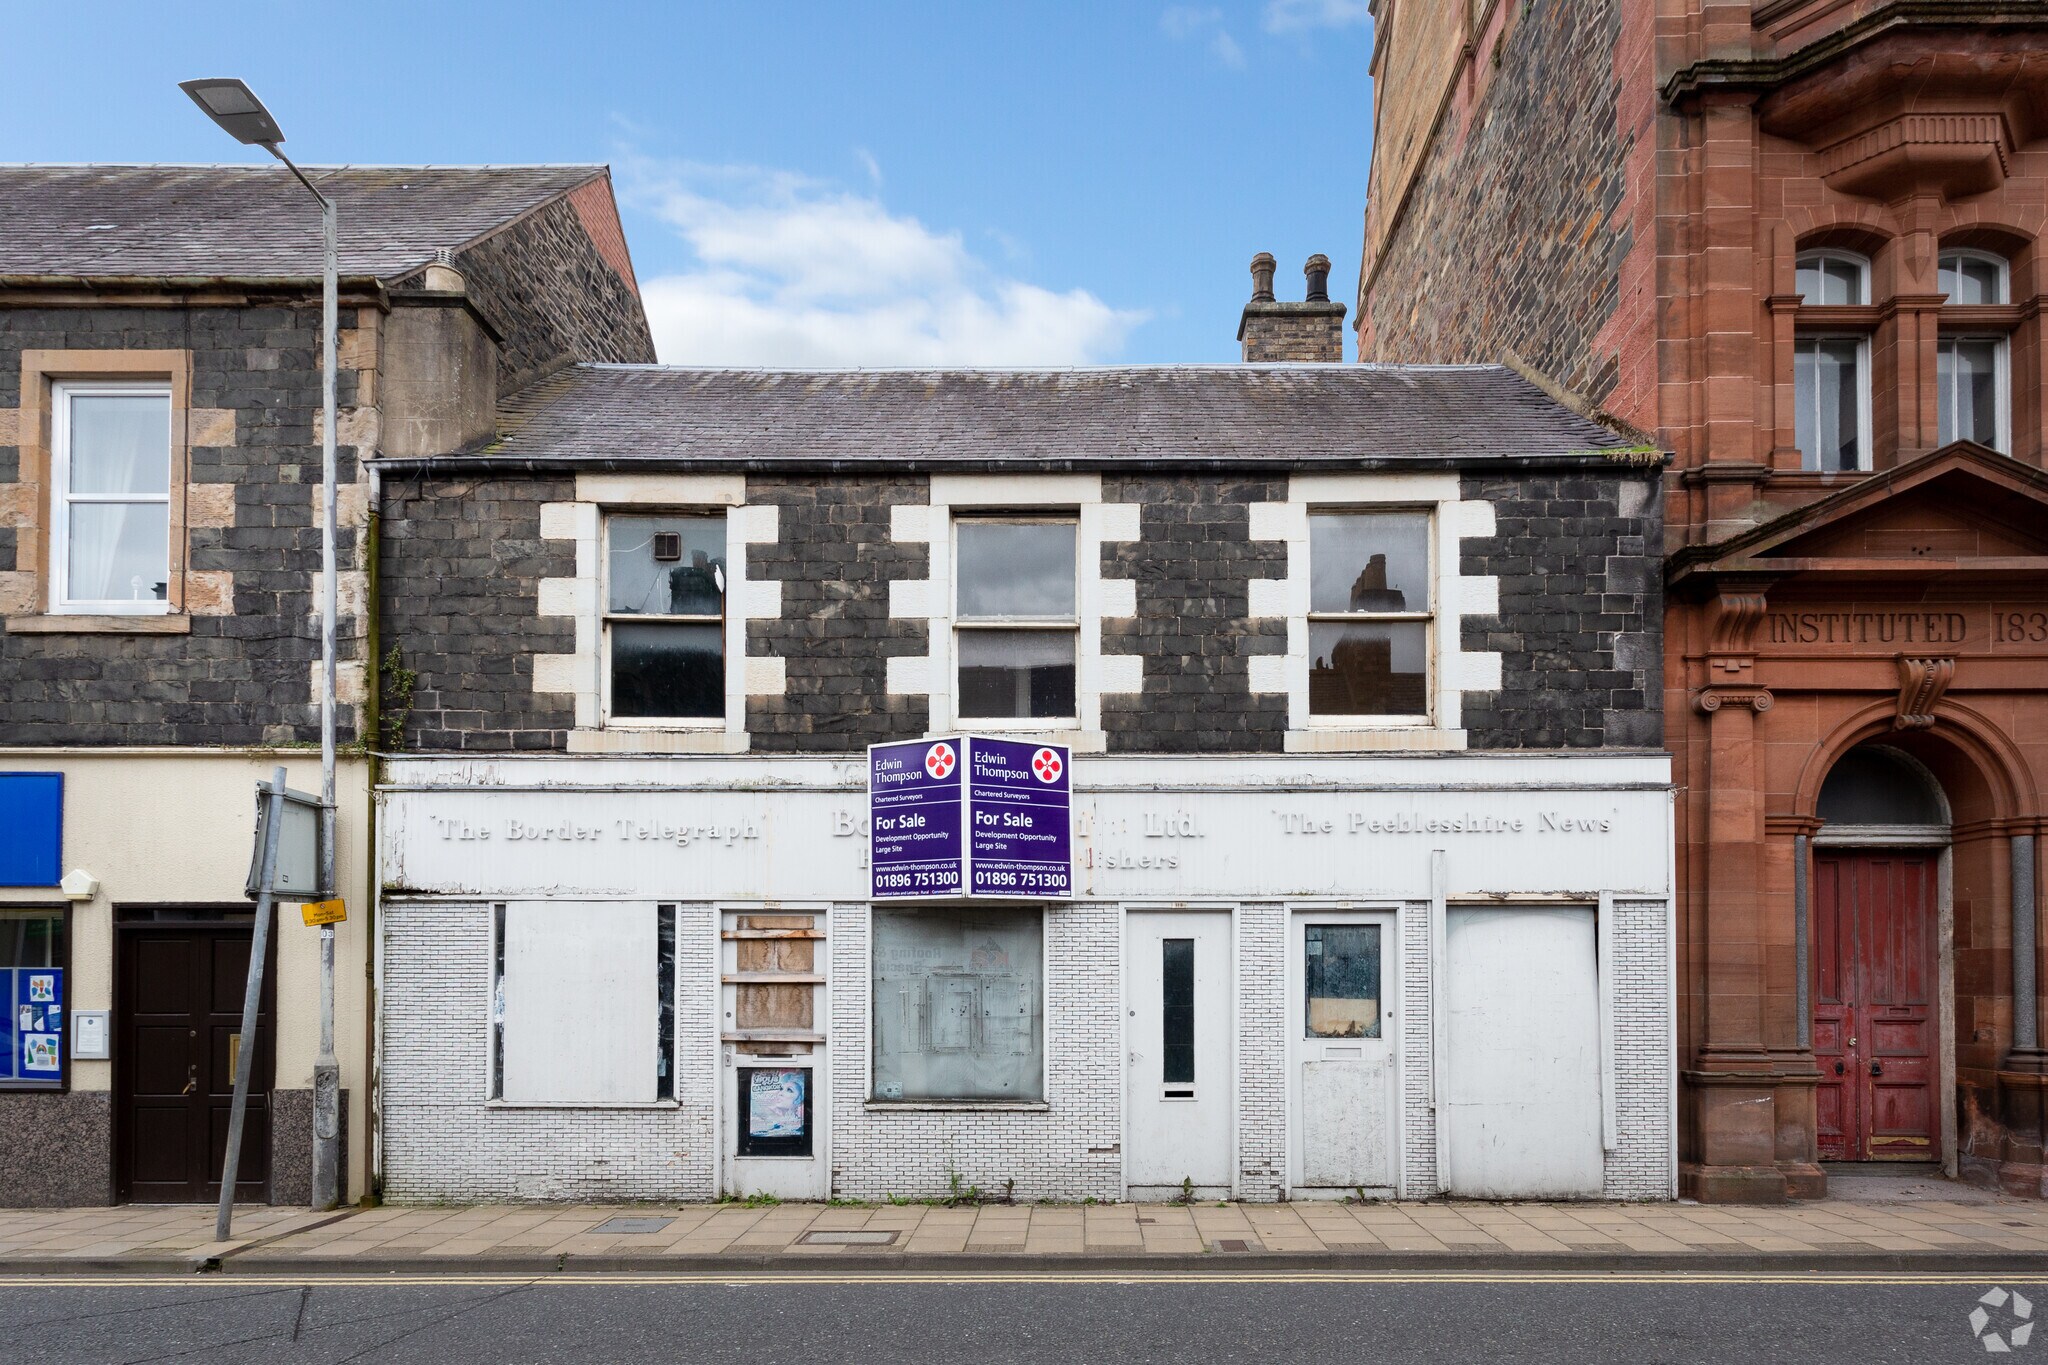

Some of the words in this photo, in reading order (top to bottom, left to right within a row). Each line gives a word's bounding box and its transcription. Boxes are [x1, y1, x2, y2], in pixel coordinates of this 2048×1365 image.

[1767, 612, 1967, 643] INSTITUTED
[875, 758, 902, 771] Edwin
[974, 751, 1007, 765] Edwin
[875, 770, 922, 785] Thompson
[974, 764, 1029, 782] Thompson
[875, 795, 898, 803] Chartered
[899, 794, 923, 802] Surveyors
[974, 789, 1003, 798] Chartered
[1003, 792, 1030, 800] Surveyors
[876, 816, 896, 830] For
[899, 813, 926, 828] Sale
[975, 810, 1000, 826] For
[1003, 812, 1033, 827] Sale
[1348, 812, 1523, 835] Peeblesshire
[504, 818, 602, 841] Border
[975, 830, 1018, 840] Development
[1019, 832, 1057, 843] Opportunity
[875, 834, 912, 843] Development
[913, 831, 949, 841] Opportunity
[875, 846, 891, 854] Large
[892, 845, 902, 853] Site
[975, 842, 994, 850] Large
[994, 842, 1007, 850] Site
[876, 862, 957, 873] www.edwin-thompson.co.uk
[975, 862, 1066, 872] www.edwin-thompson.co.uk
[876, 873, 911, 888] 01896
[914, 871, 959, 886] 751300
[975, 871, 1017, 885] 01896
[1020, 873, 1067, 887] 751300
